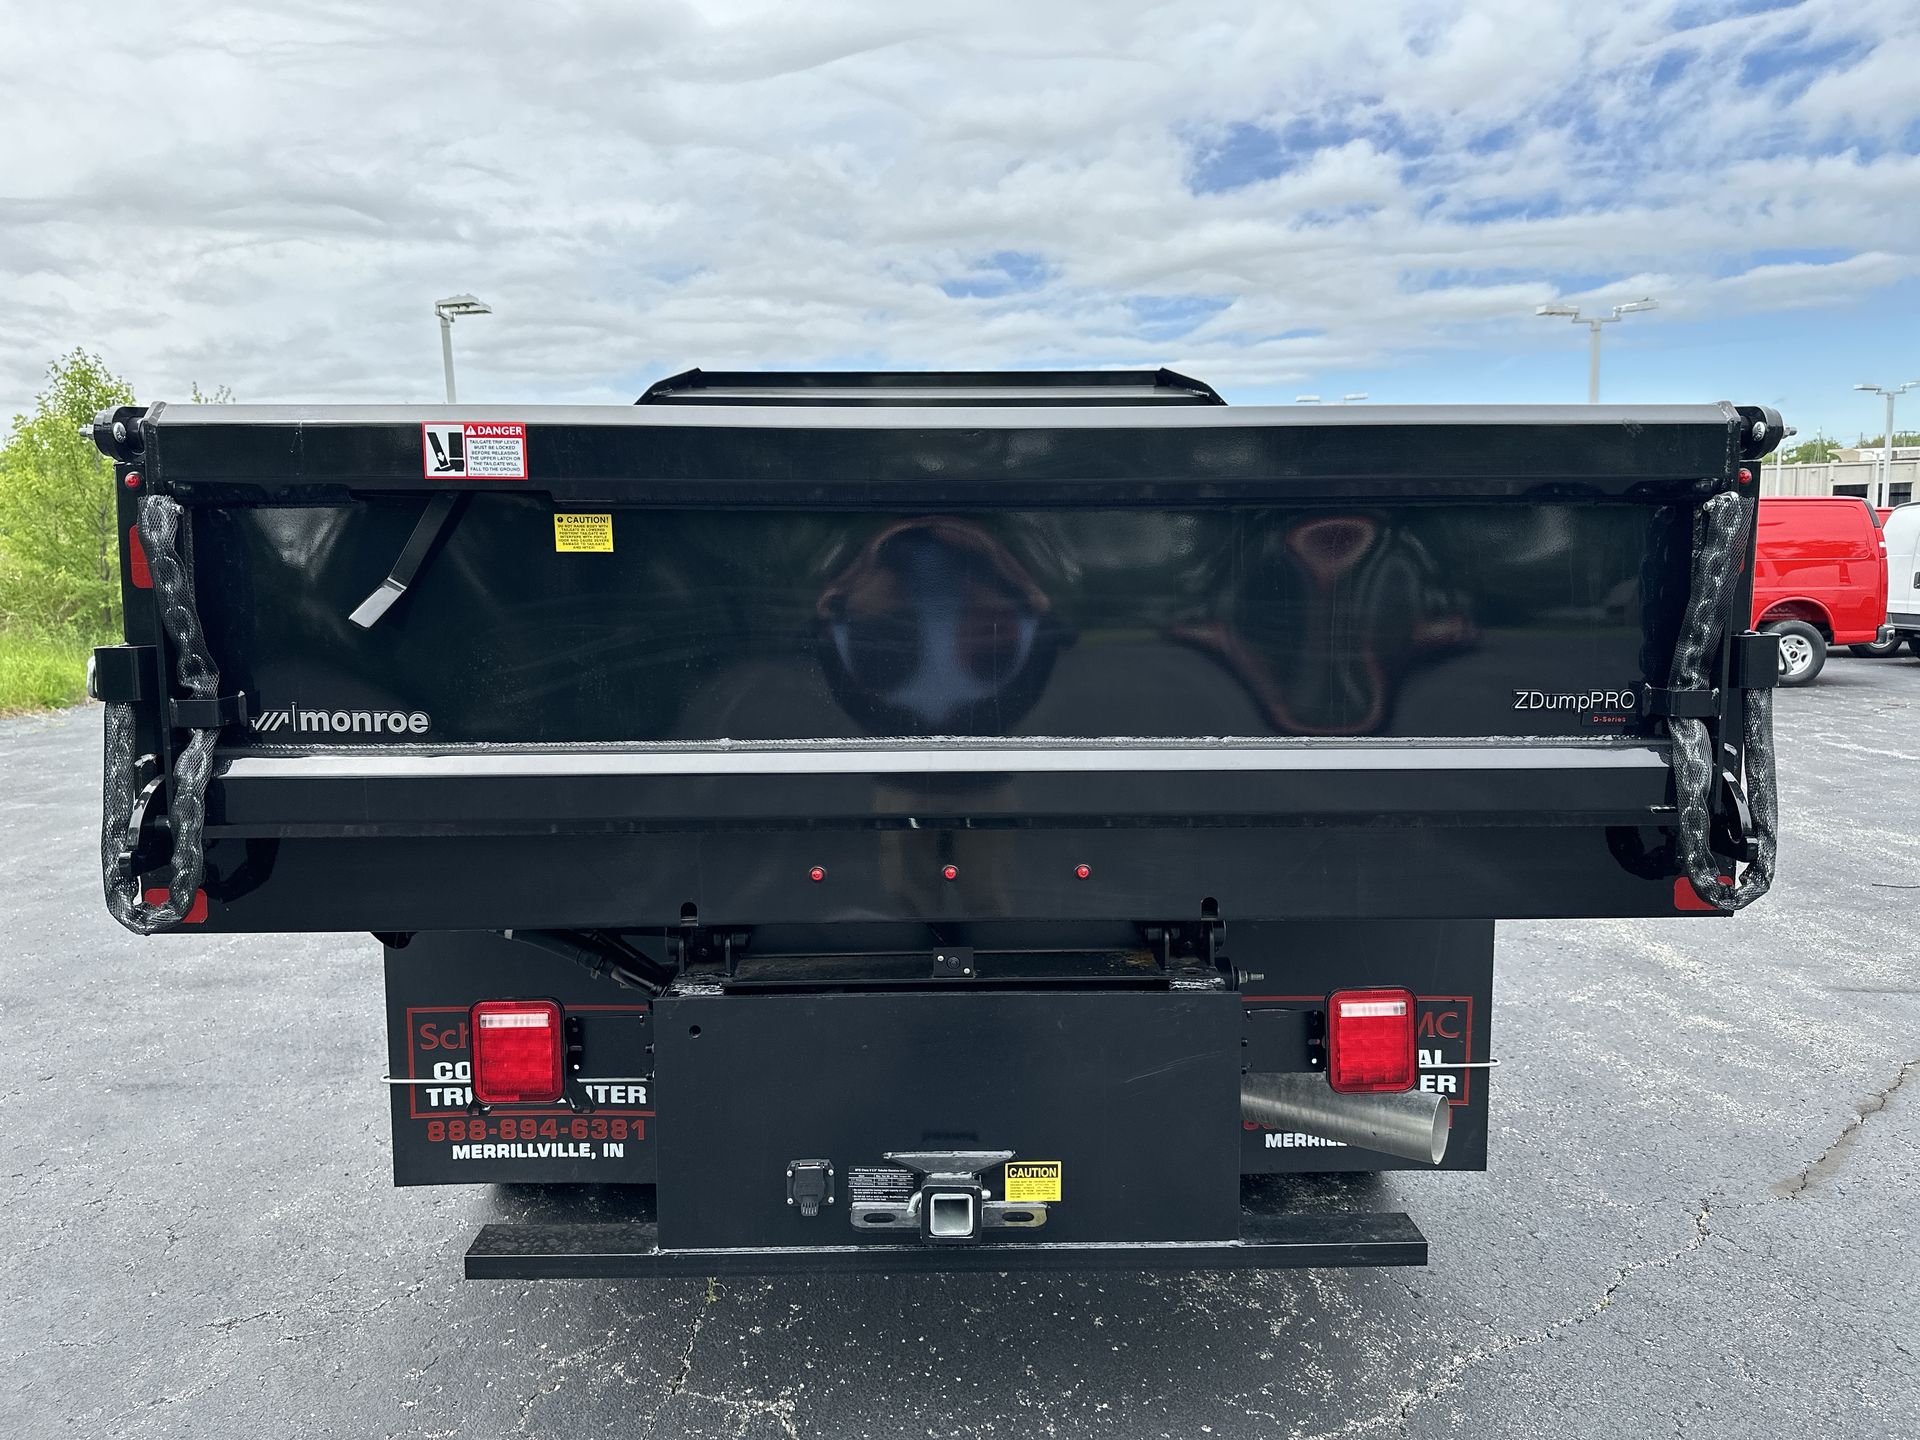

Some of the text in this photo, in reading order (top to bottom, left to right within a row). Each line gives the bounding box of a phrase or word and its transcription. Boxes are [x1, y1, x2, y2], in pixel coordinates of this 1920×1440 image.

[478, 426, 522, 435] DANGER
[1514, 691, 1636, 713] ZDumpPRO
[300, 711, 429, 733] monroe
[1418, 1011, 1460, 1038] MC
[426, 1118, 645, 1142] 888-894-6381
[452, 1143, 624, 1160] MERRILLVILLE, IN
[1009, 1168, 1057, 1178] CAUTION
